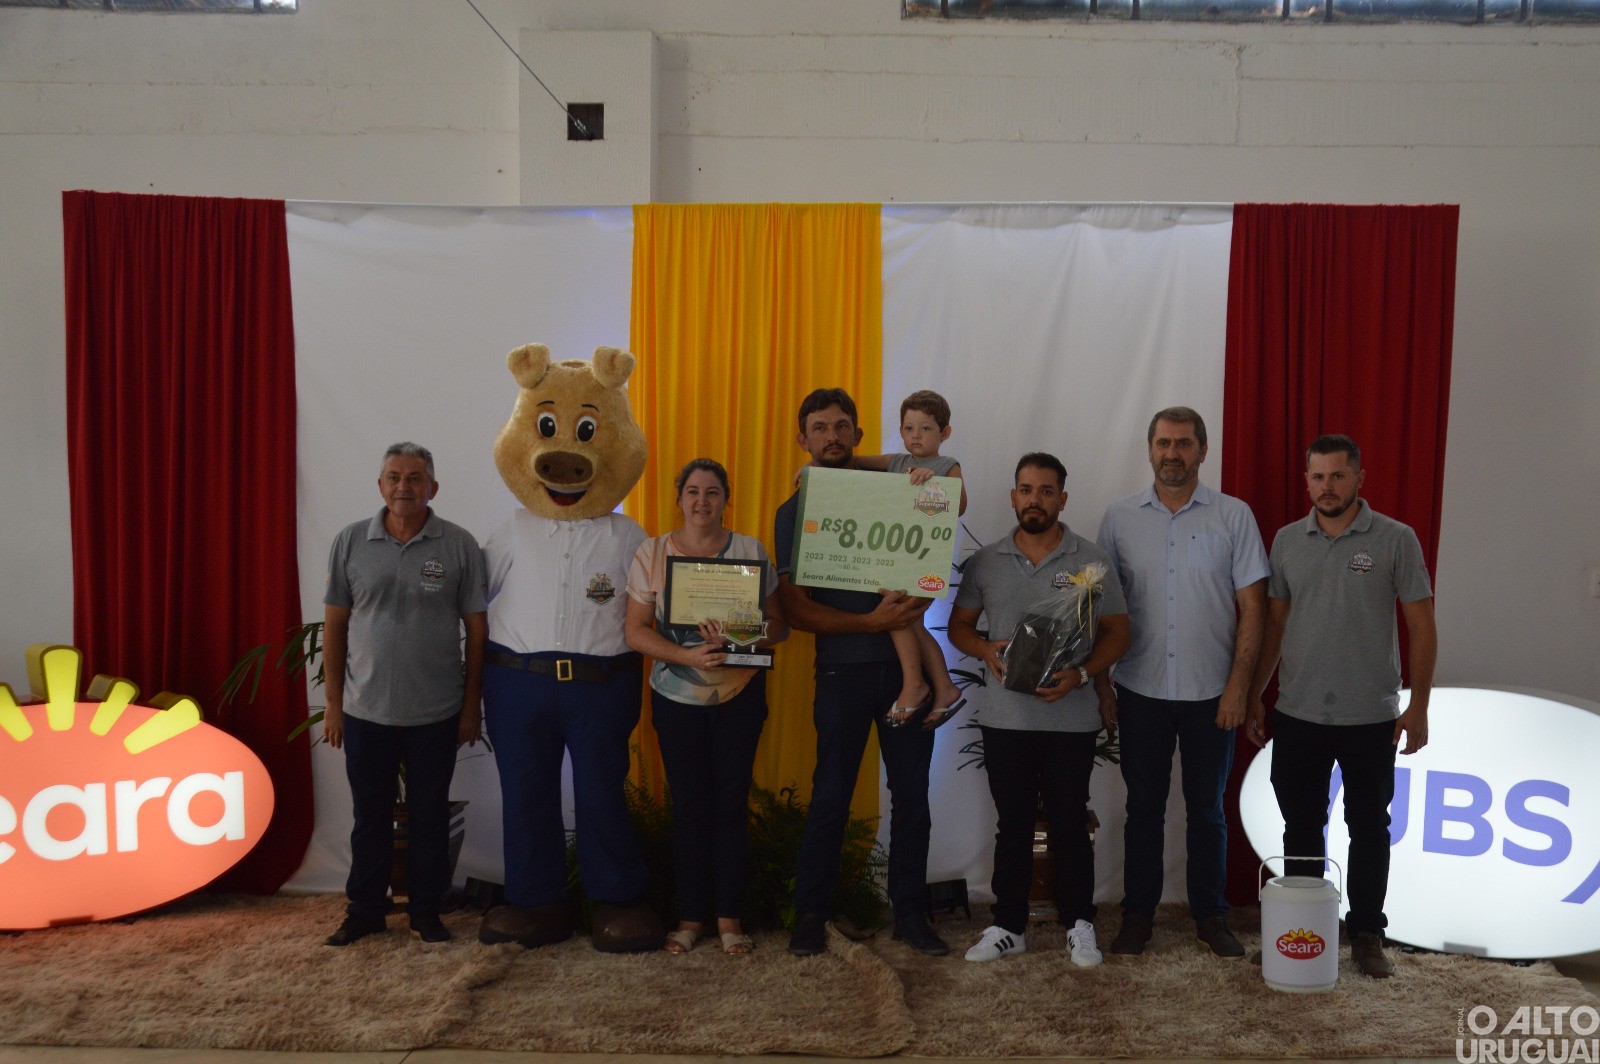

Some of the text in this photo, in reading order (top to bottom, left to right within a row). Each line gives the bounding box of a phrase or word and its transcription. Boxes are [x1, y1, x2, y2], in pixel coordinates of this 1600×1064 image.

[804, 552, 895, 567] 2023 2023 2023 2023
[802, 572, 881, 586] Seara Alimentos Ltda.
[919, 579, 943, 589] Seara
[0, 771, 245, 864] ara
[1278, 939, 1322, 953] Seara
